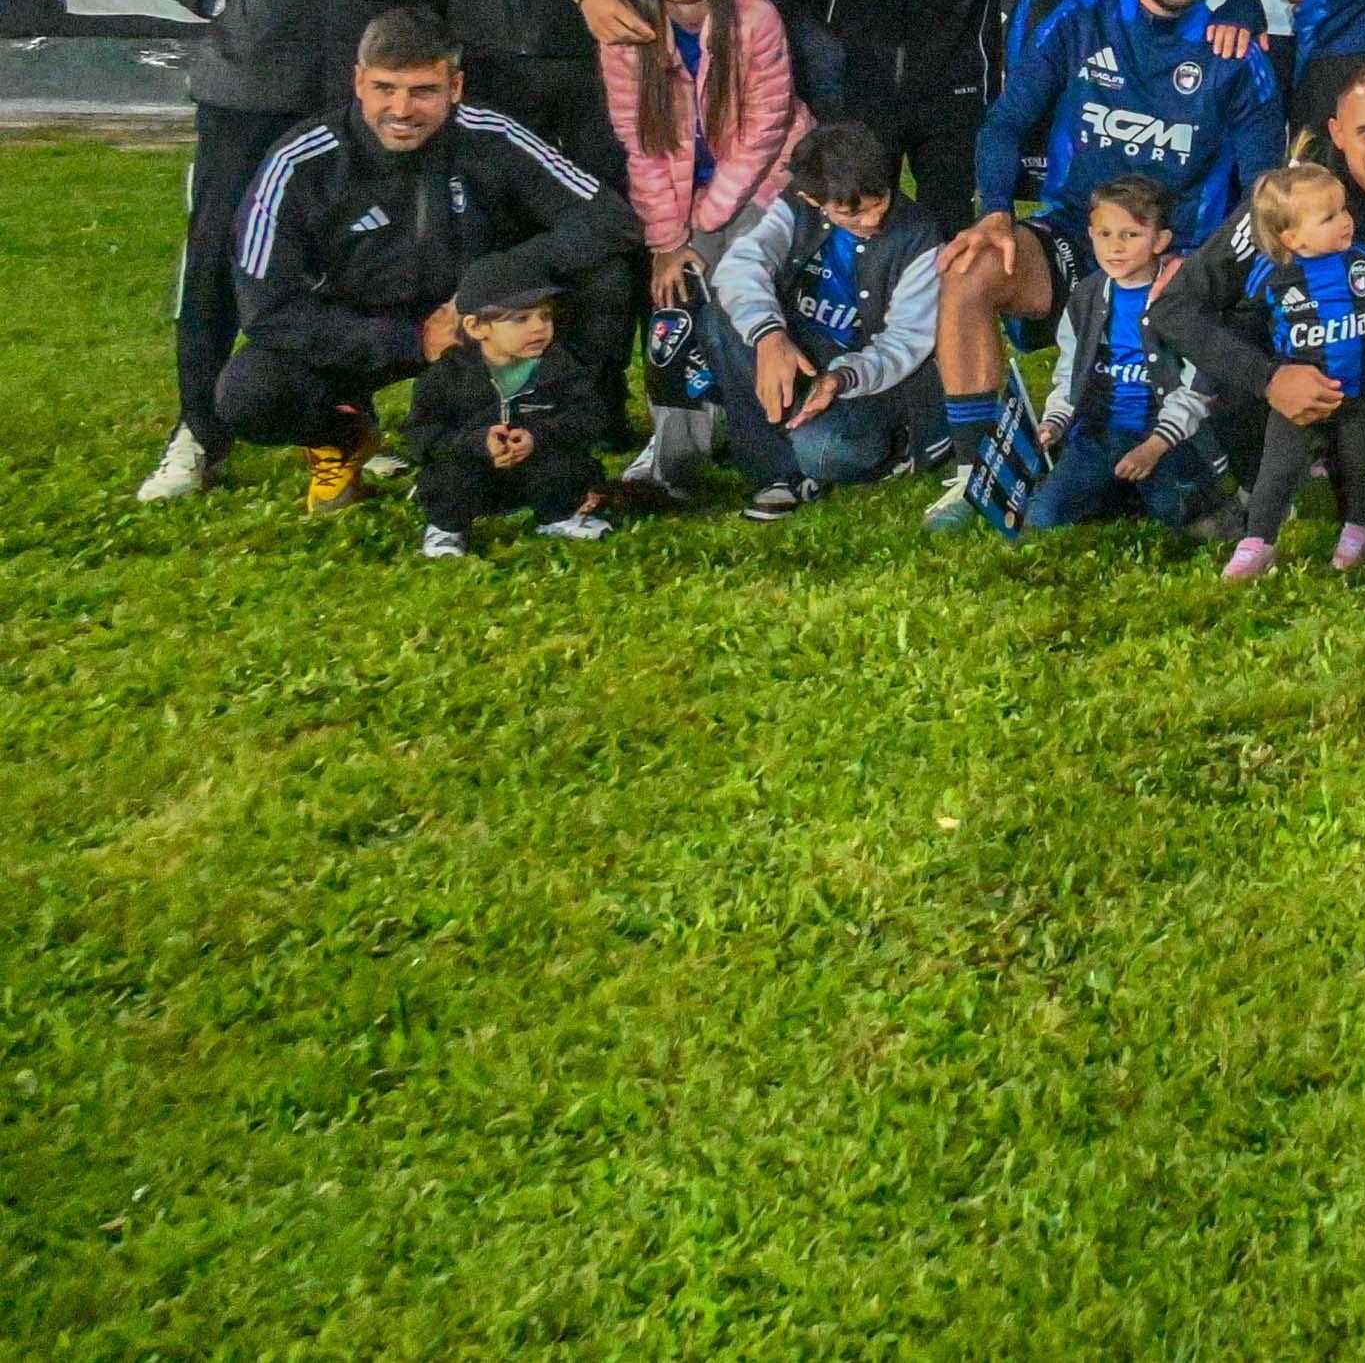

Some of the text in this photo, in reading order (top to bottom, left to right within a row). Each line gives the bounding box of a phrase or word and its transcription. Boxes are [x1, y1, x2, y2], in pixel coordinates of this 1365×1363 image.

[1081, 130, 1191, 167] SPORT
[797, 288, 863, 330] etil
[1005, 479, 1026, 512] Iris
